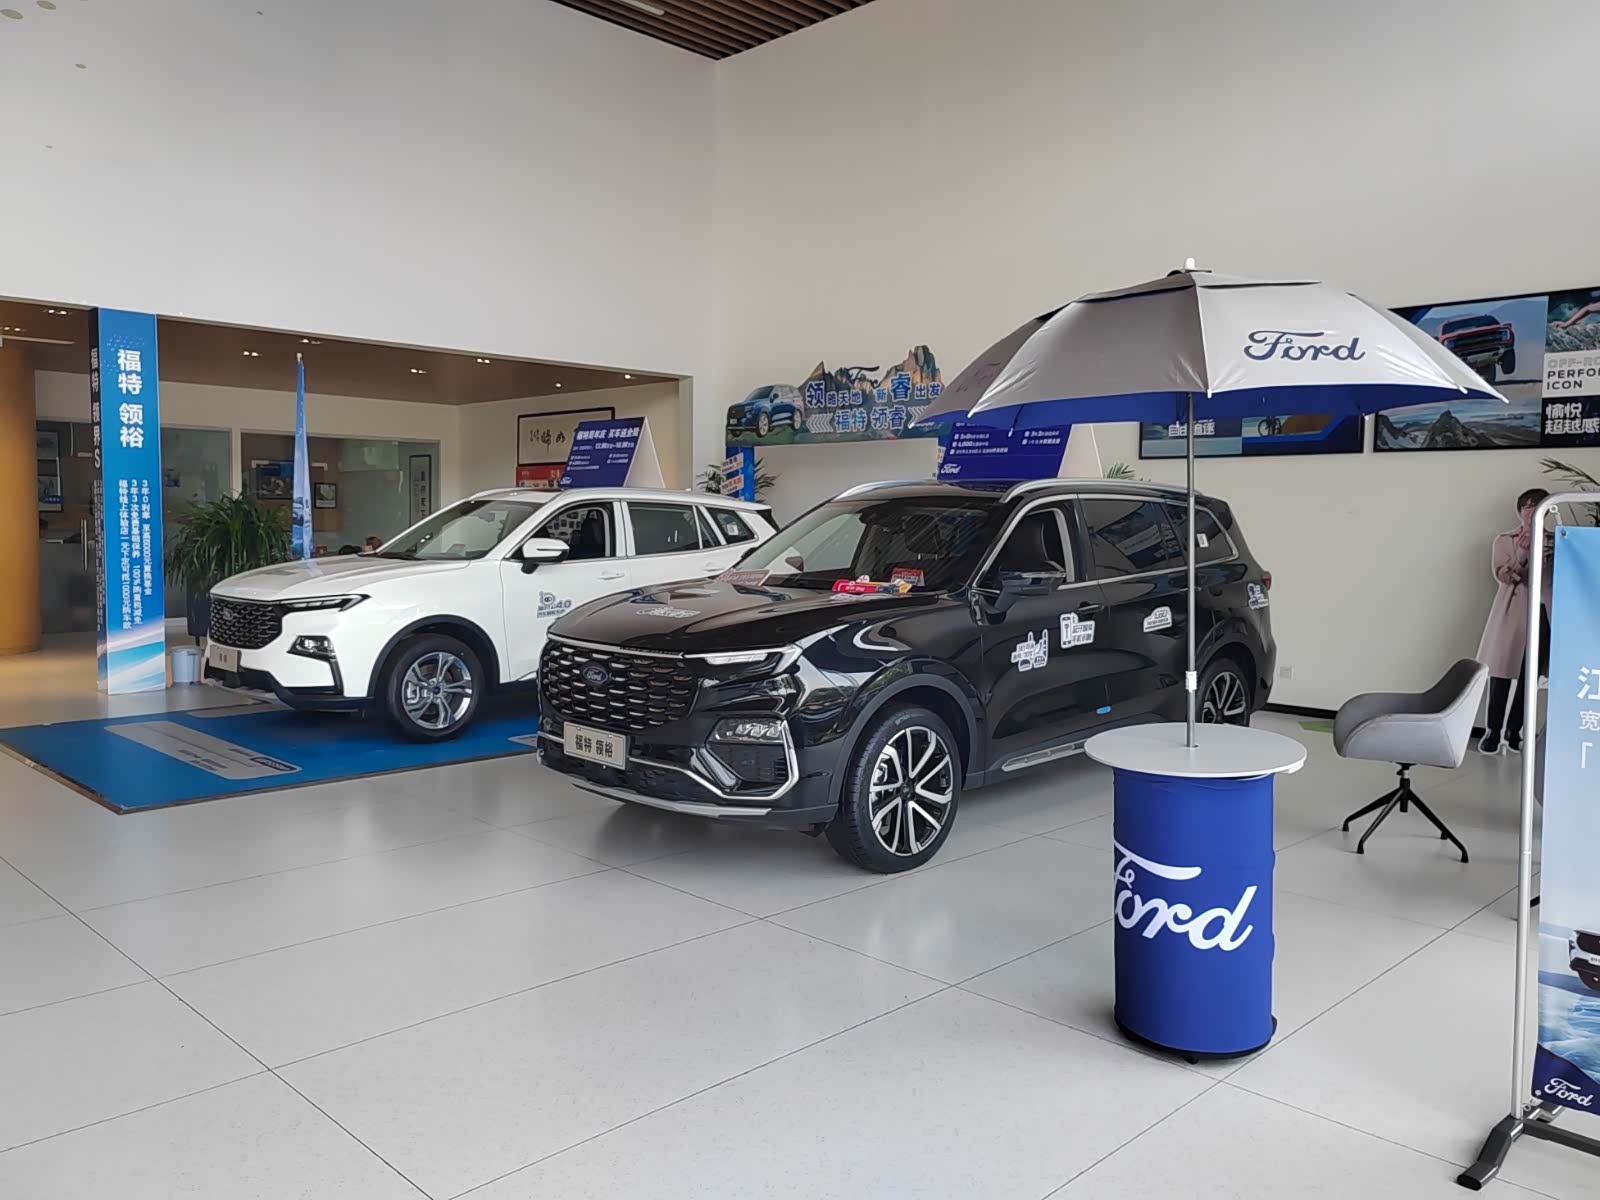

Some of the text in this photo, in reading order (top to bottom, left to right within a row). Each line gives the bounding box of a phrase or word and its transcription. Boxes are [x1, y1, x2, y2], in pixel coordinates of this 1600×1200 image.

[1244, 330, 1366, 361] Ford
[1547, 367, 1600, 379] PERFO
[1546, 380, 1583, 391] ICON
[117, 349, 144, 449] 福特 领裕
[835, 405, 906, 432] 福特 领睿
[1545, 402, 1583, 419] 愉悦
[1544, 417, 1600, 435] 超越感
[575, 733, 592, 754] 福特
[1544, 1077, 1594, 1107] Ford
